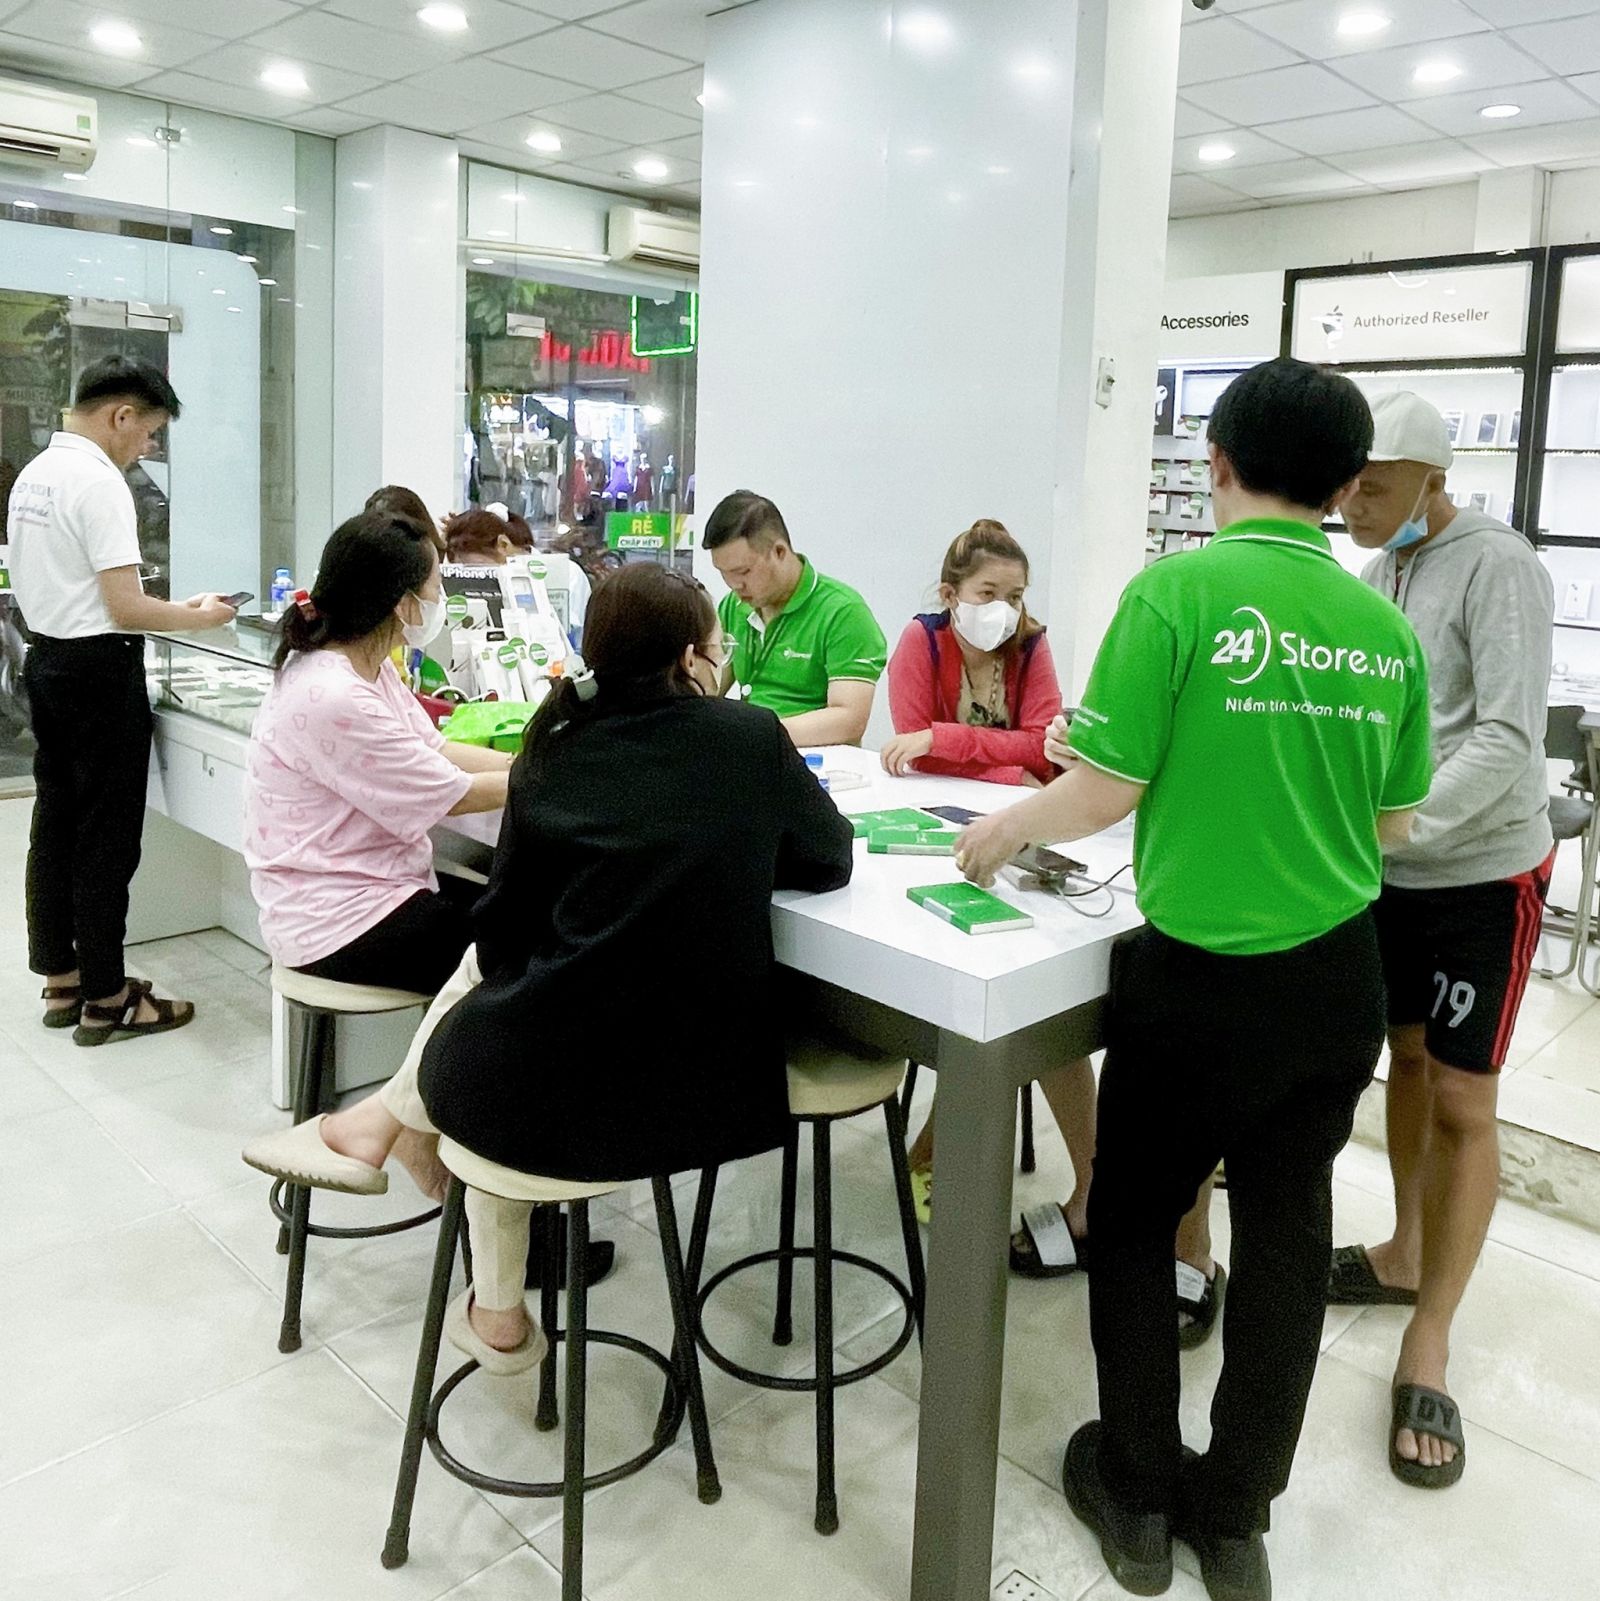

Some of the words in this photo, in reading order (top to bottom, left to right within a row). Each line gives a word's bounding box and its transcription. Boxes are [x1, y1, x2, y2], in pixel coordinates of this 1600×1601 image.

[1160, 311, 1249, 330] Accessories
[1353, 311, 1429, 328] Authorized
[1432, 308, 1489, 324] Reseller
[443, 566, 486, 580] iPhone
[1279, 632, 1405, 683] Store.vn
